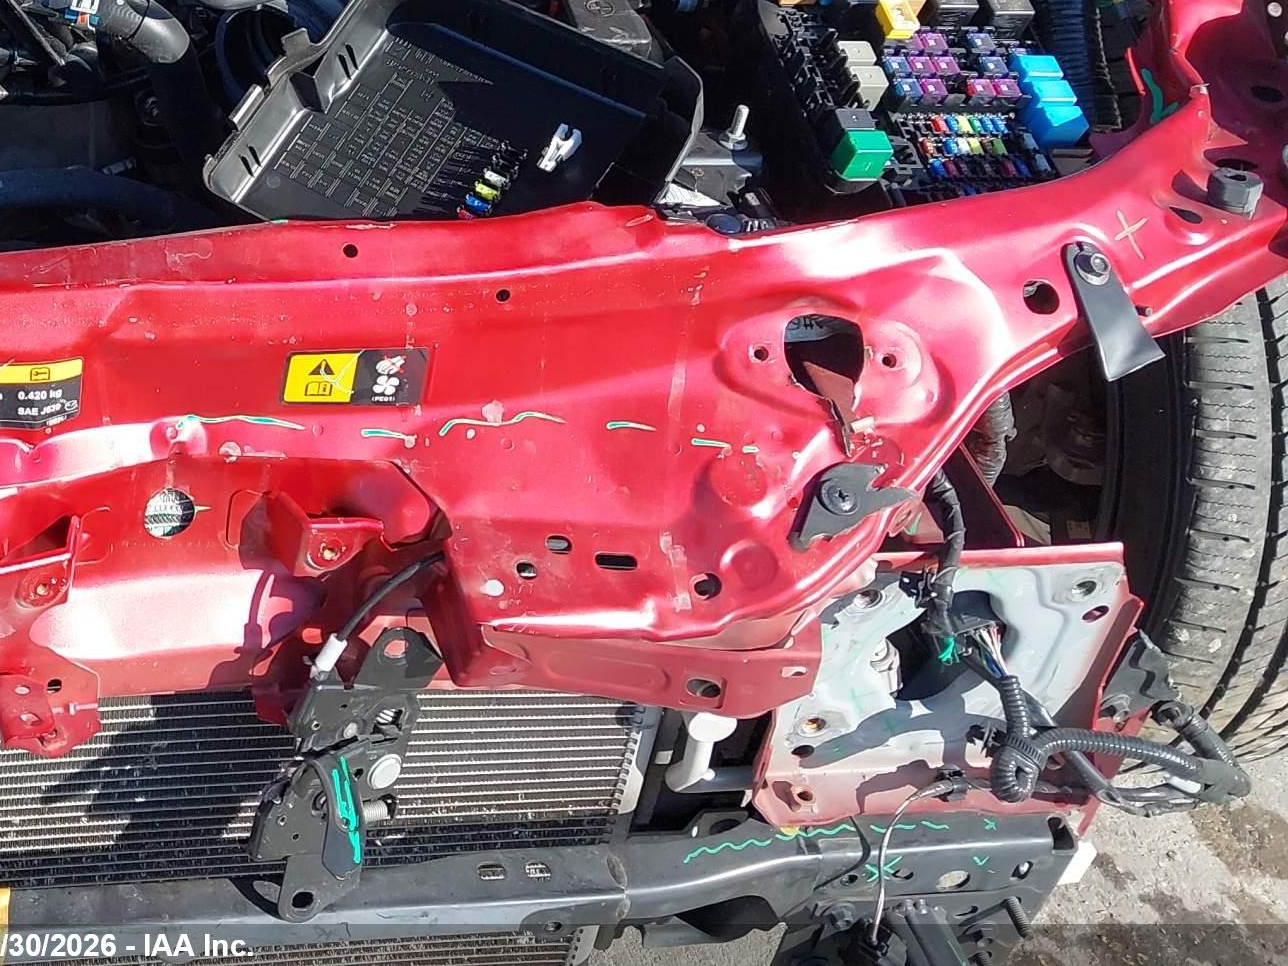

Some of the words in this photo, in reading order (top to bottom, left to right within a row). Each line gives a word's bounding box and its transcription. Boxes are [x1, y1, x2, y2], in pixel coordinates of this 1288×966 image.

[18, 391, 47, 401] 0.420
[49, 388, 63, 399] kg
[18, 407, 38, 416] SAE
